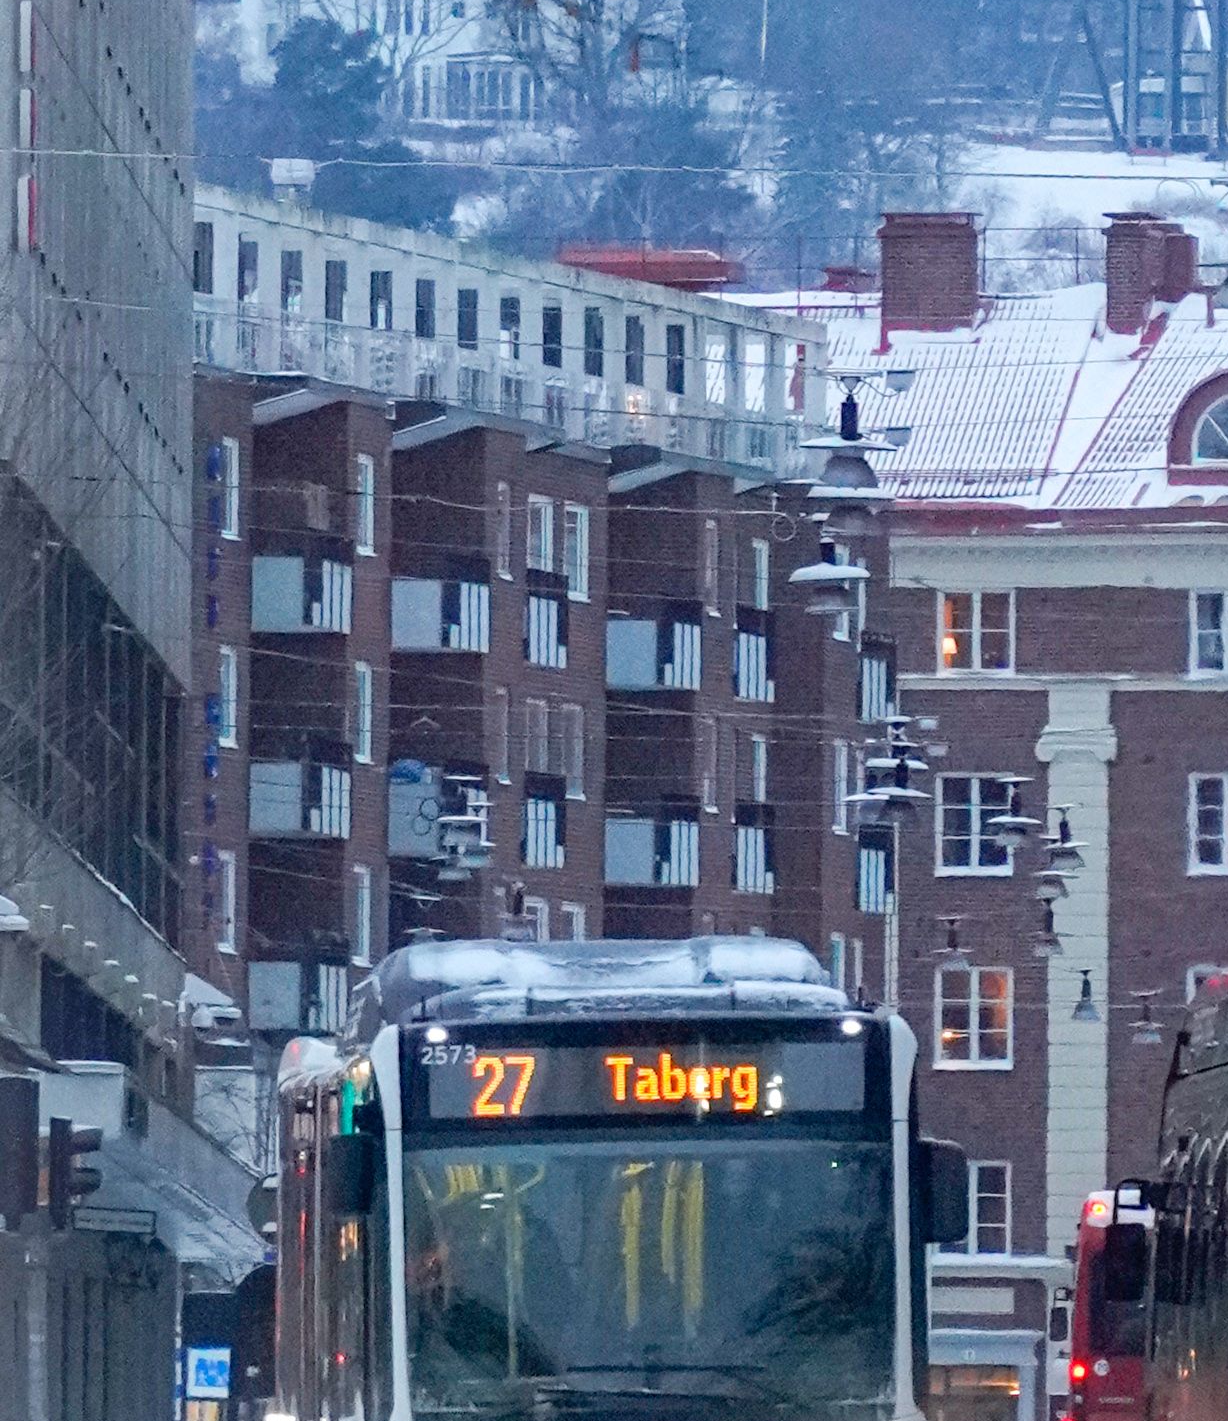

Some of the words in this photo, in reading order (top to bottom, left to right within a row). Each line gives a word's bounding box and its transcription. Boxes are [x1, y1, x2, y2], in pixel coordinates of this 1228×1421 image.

[421, 1045, 477, 1066] 2573
[471, 1055, 536, 1116] 27
[604, 1052, 759, 1112] Taberg
